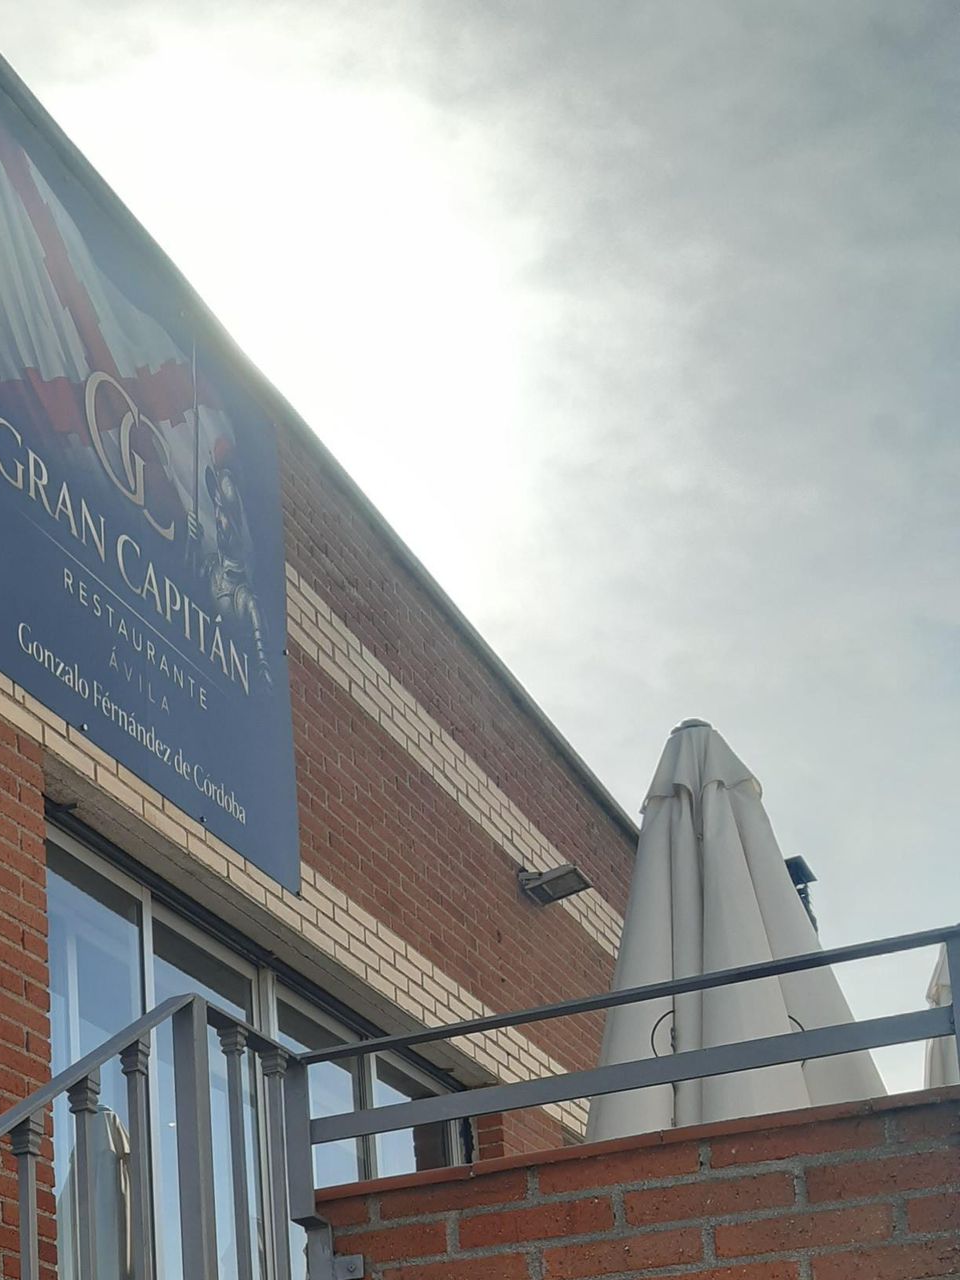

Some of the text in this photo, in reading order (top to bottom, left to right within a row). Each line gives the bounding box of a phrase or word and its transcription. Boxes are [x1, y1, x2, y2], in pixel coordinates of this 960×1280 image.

[63, 567, 209, 711] RESTAURANTE
[108, 646, 170, 715] ÁVILA
[116, 534, 250, 696] CAPITÁN
[18, 622, 247, 826] Gonzalo Férnández de Córdoba
